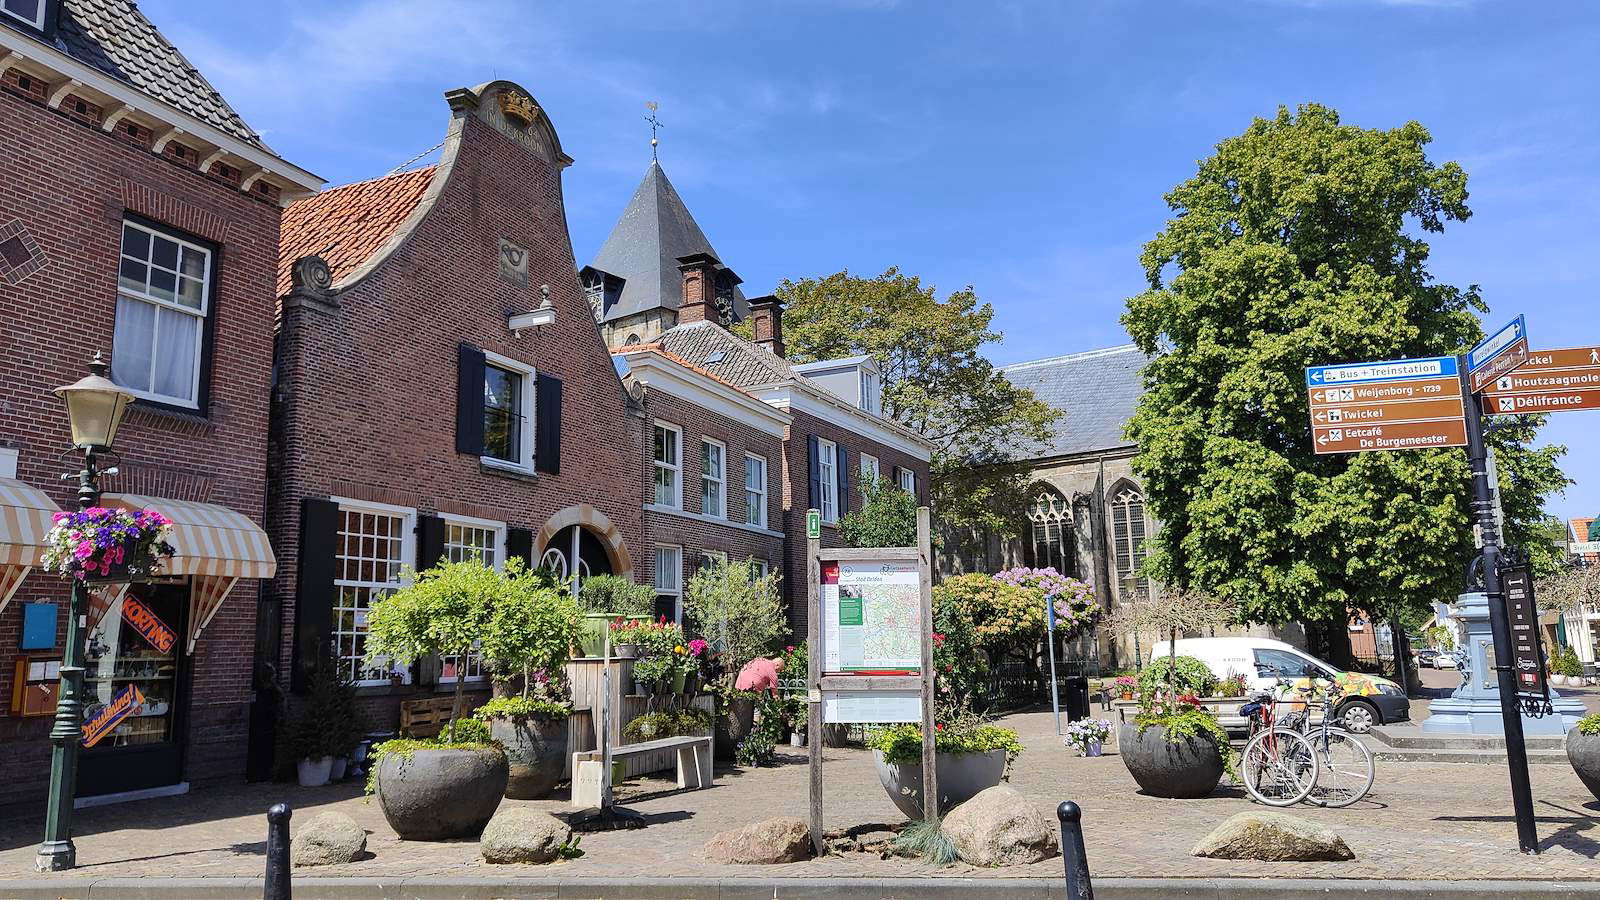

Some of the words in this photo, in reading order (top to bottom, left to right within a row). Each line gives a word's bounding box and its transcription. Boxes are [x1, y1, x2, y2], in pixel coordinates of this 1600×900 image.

[1525, 355, 1553, 366] ckel
[1340, 370, 1359, 379] Bus
[1371, 363, 1437, 377] Treinstation
[1514, 373, 1600, 387] Houtzaagmole
[1356, 386, 1413, 398] Weijenborg
[1422, 384, 1441, 393] 1739
[1516, 394, 1582, 408] Délifrance
[1342, 408, 1383, 419] Twickel
[1345, 427, 1382, 438] Eetcafé
[1360, 439, 1374, 448] De
[1376, 434, 1448, 448] Burgemeester
[122, 596, 174, 650] KORTING
